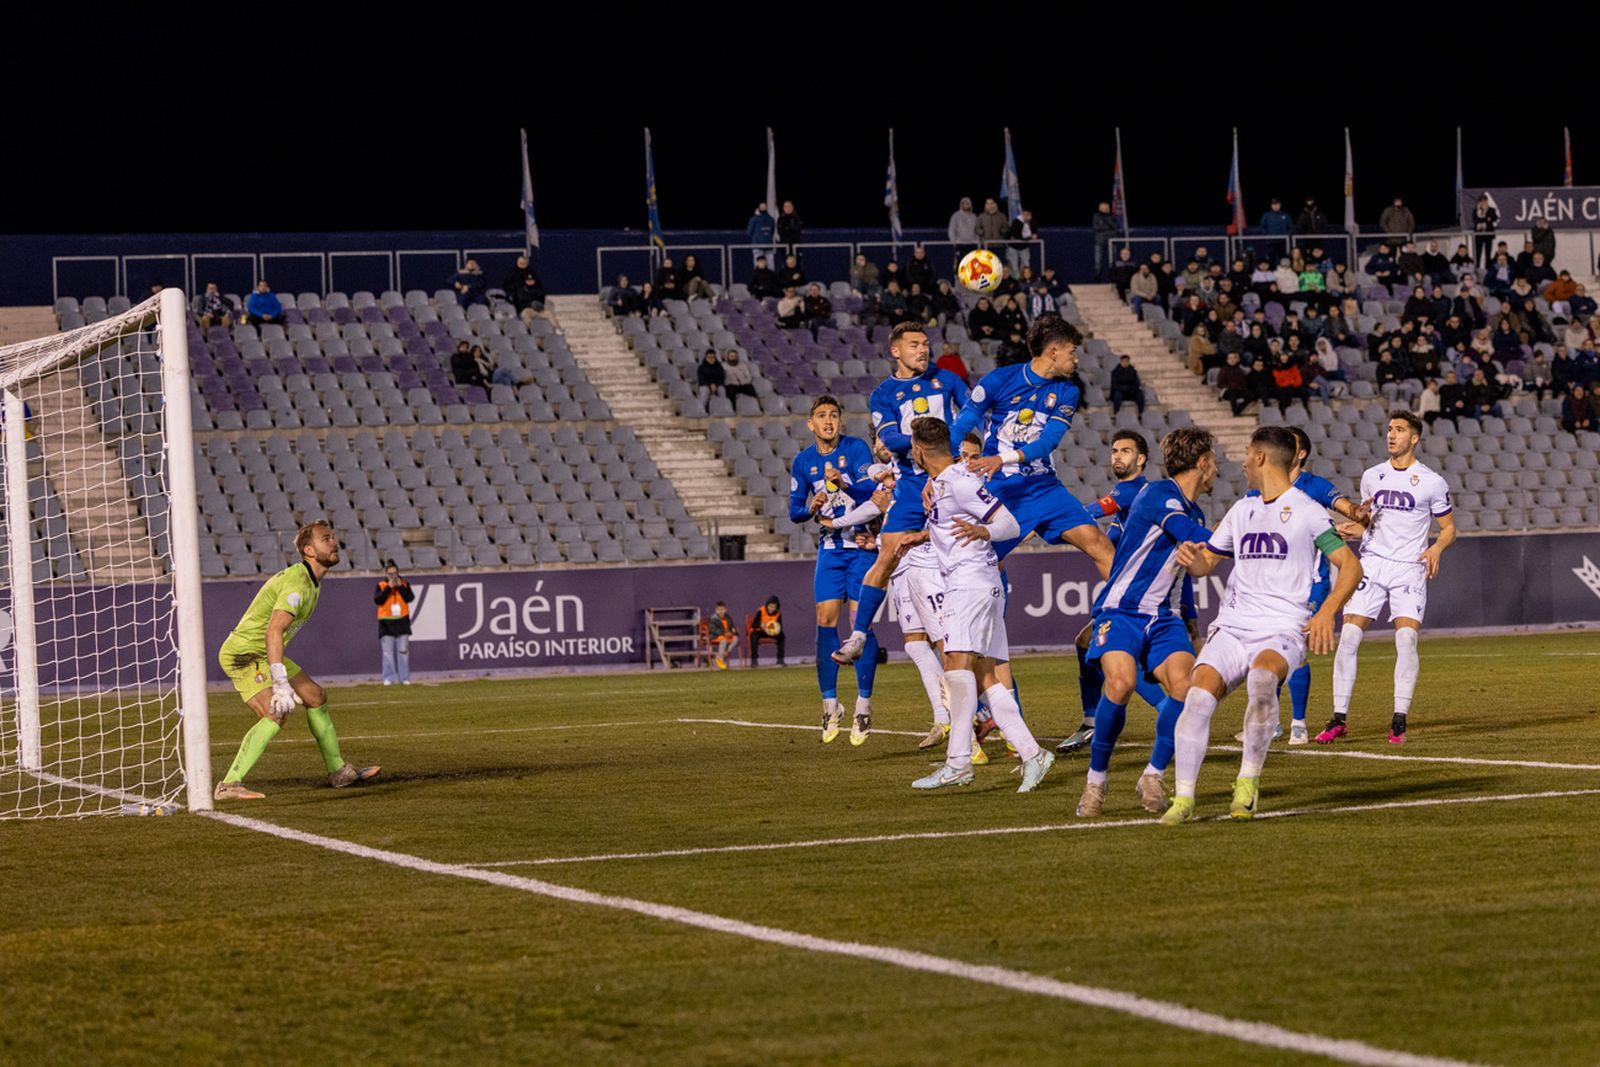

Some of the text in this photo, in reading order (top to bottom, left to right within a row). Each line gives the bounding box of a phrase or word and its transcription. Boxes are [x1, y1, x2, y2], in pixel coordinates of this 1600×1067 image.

[1515, 192, 1600, 222] JAÉN C
[455, 580, 585, 639] Jaén
[1024, 572, 1107, 618] Ja
[458, 636, 634, 660] PARAÍSO INTERIOR
